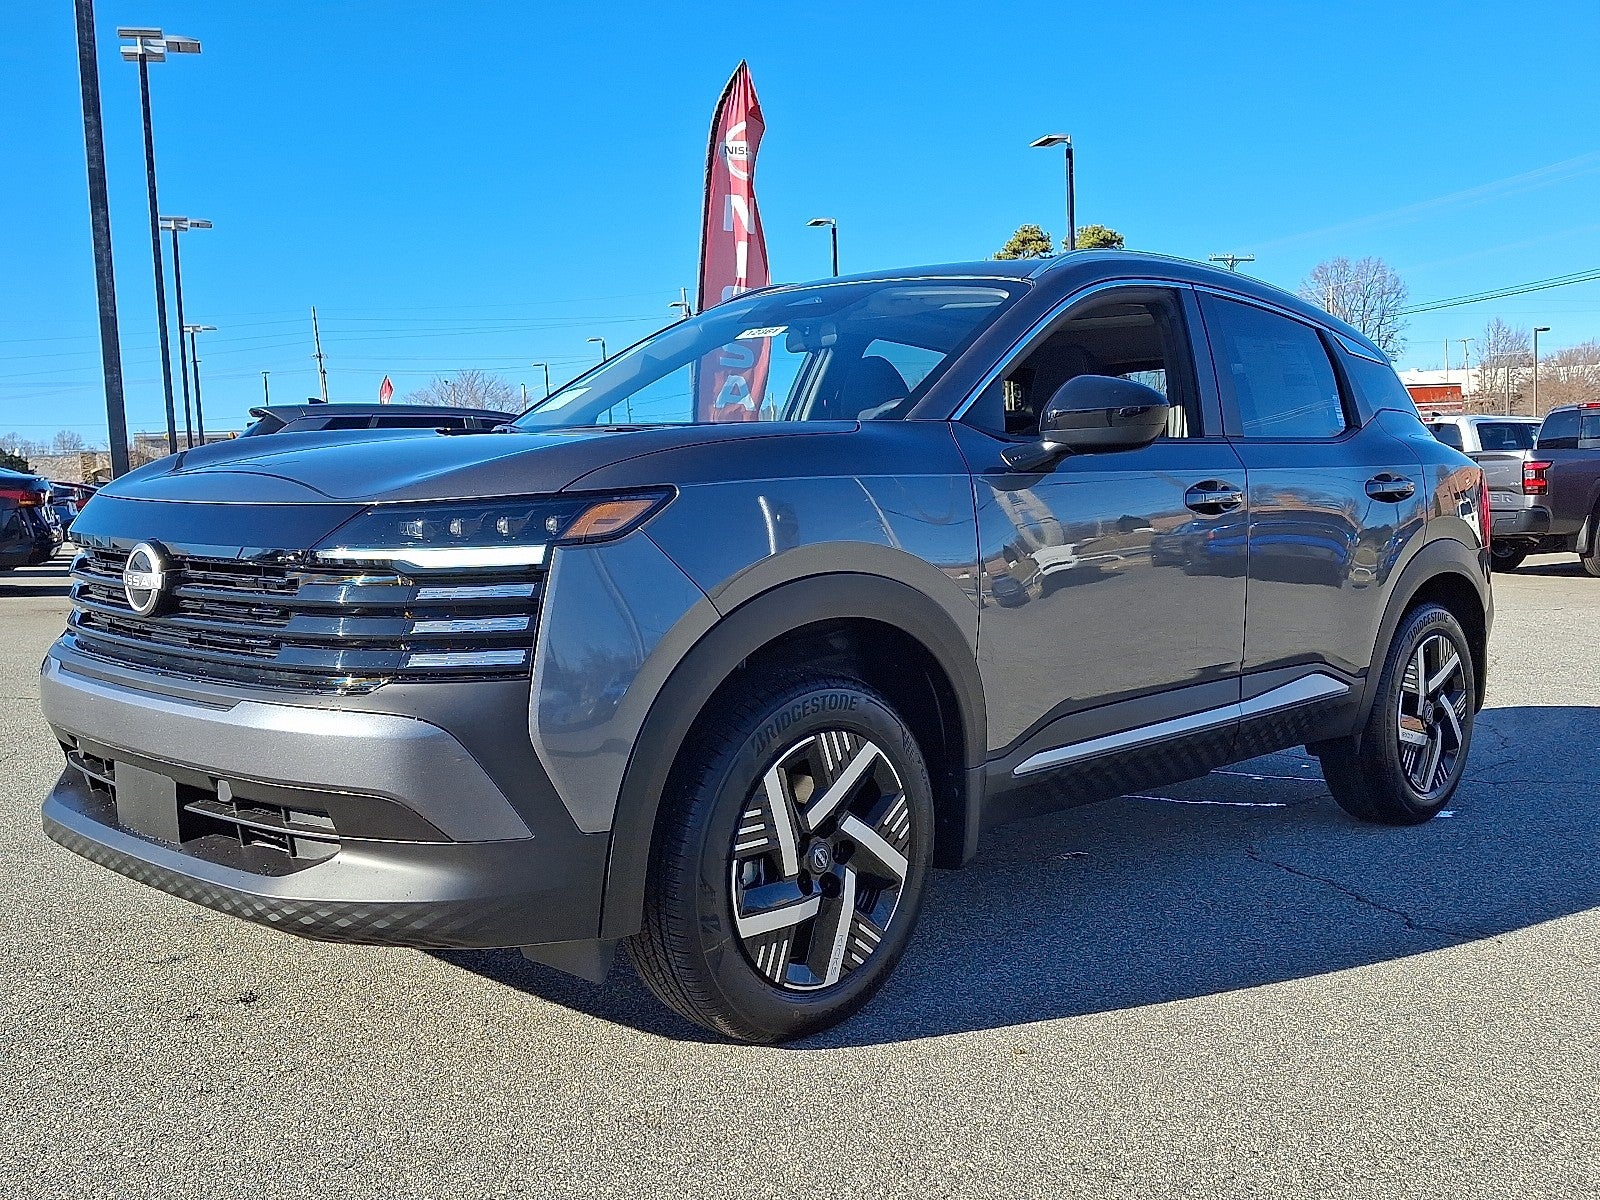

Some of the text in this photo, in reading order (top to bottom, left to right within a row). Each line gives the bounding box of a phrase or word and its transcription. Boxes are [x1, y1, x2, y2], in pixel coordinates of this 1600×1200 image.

[725, 145, 748, 155] NIS
[1408, 612, 1449, 645] BRIDGESTONE
[751, 693, 857, 757] BRIDGESTONE
